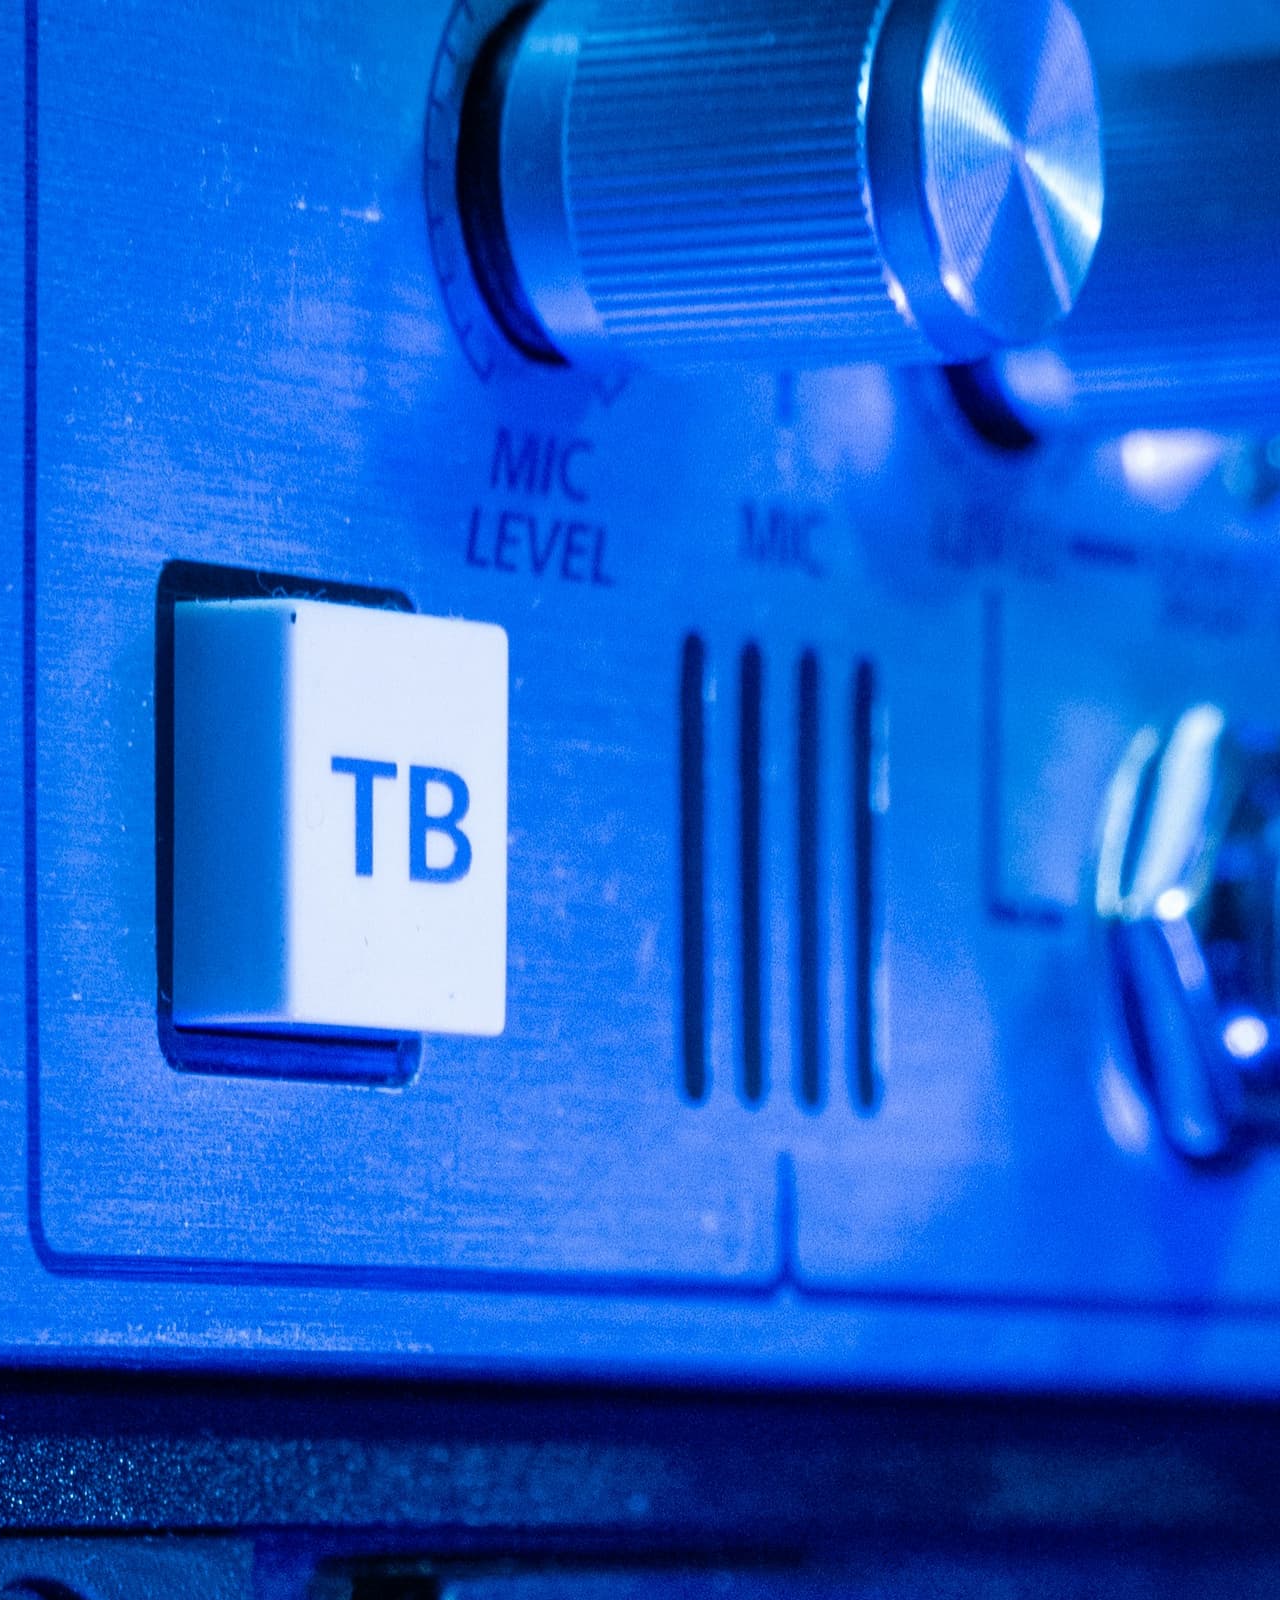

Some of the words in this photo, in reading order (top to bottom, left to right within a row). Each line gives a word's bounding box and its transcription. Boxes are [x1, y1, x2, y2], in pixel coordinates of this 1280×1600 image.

[490, 426, 594, 504] MIC
[465, 505, 616, 588] LEVEL
[331, 756, 472, 884] TB
